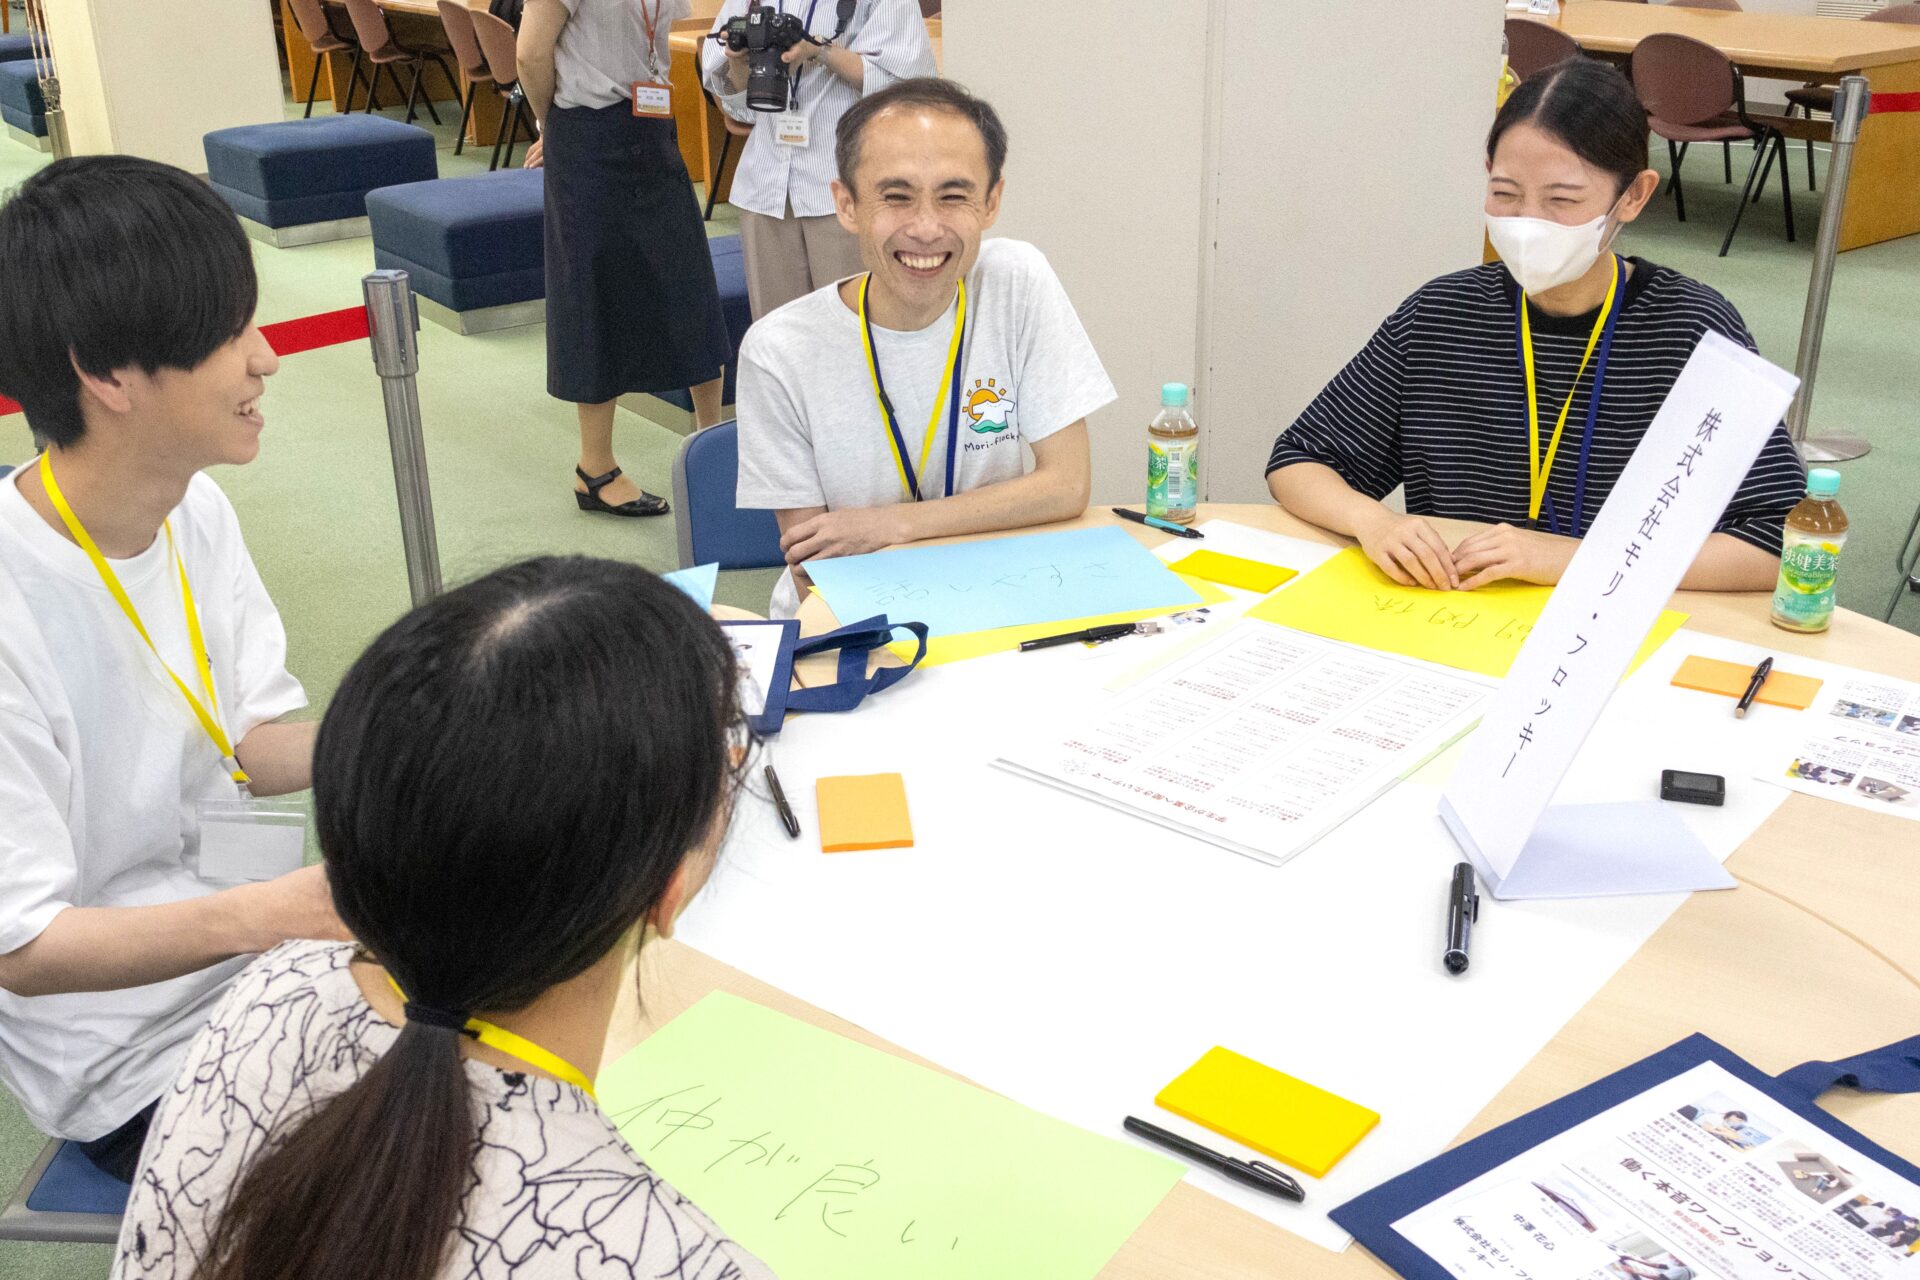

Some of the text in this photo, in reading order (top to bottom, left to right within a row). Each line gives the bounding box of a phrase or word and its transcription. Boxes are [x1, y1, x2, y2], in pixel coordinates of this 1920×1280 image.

[1502, 407, 1723, 778] 株式会社モリ・フロッキー
